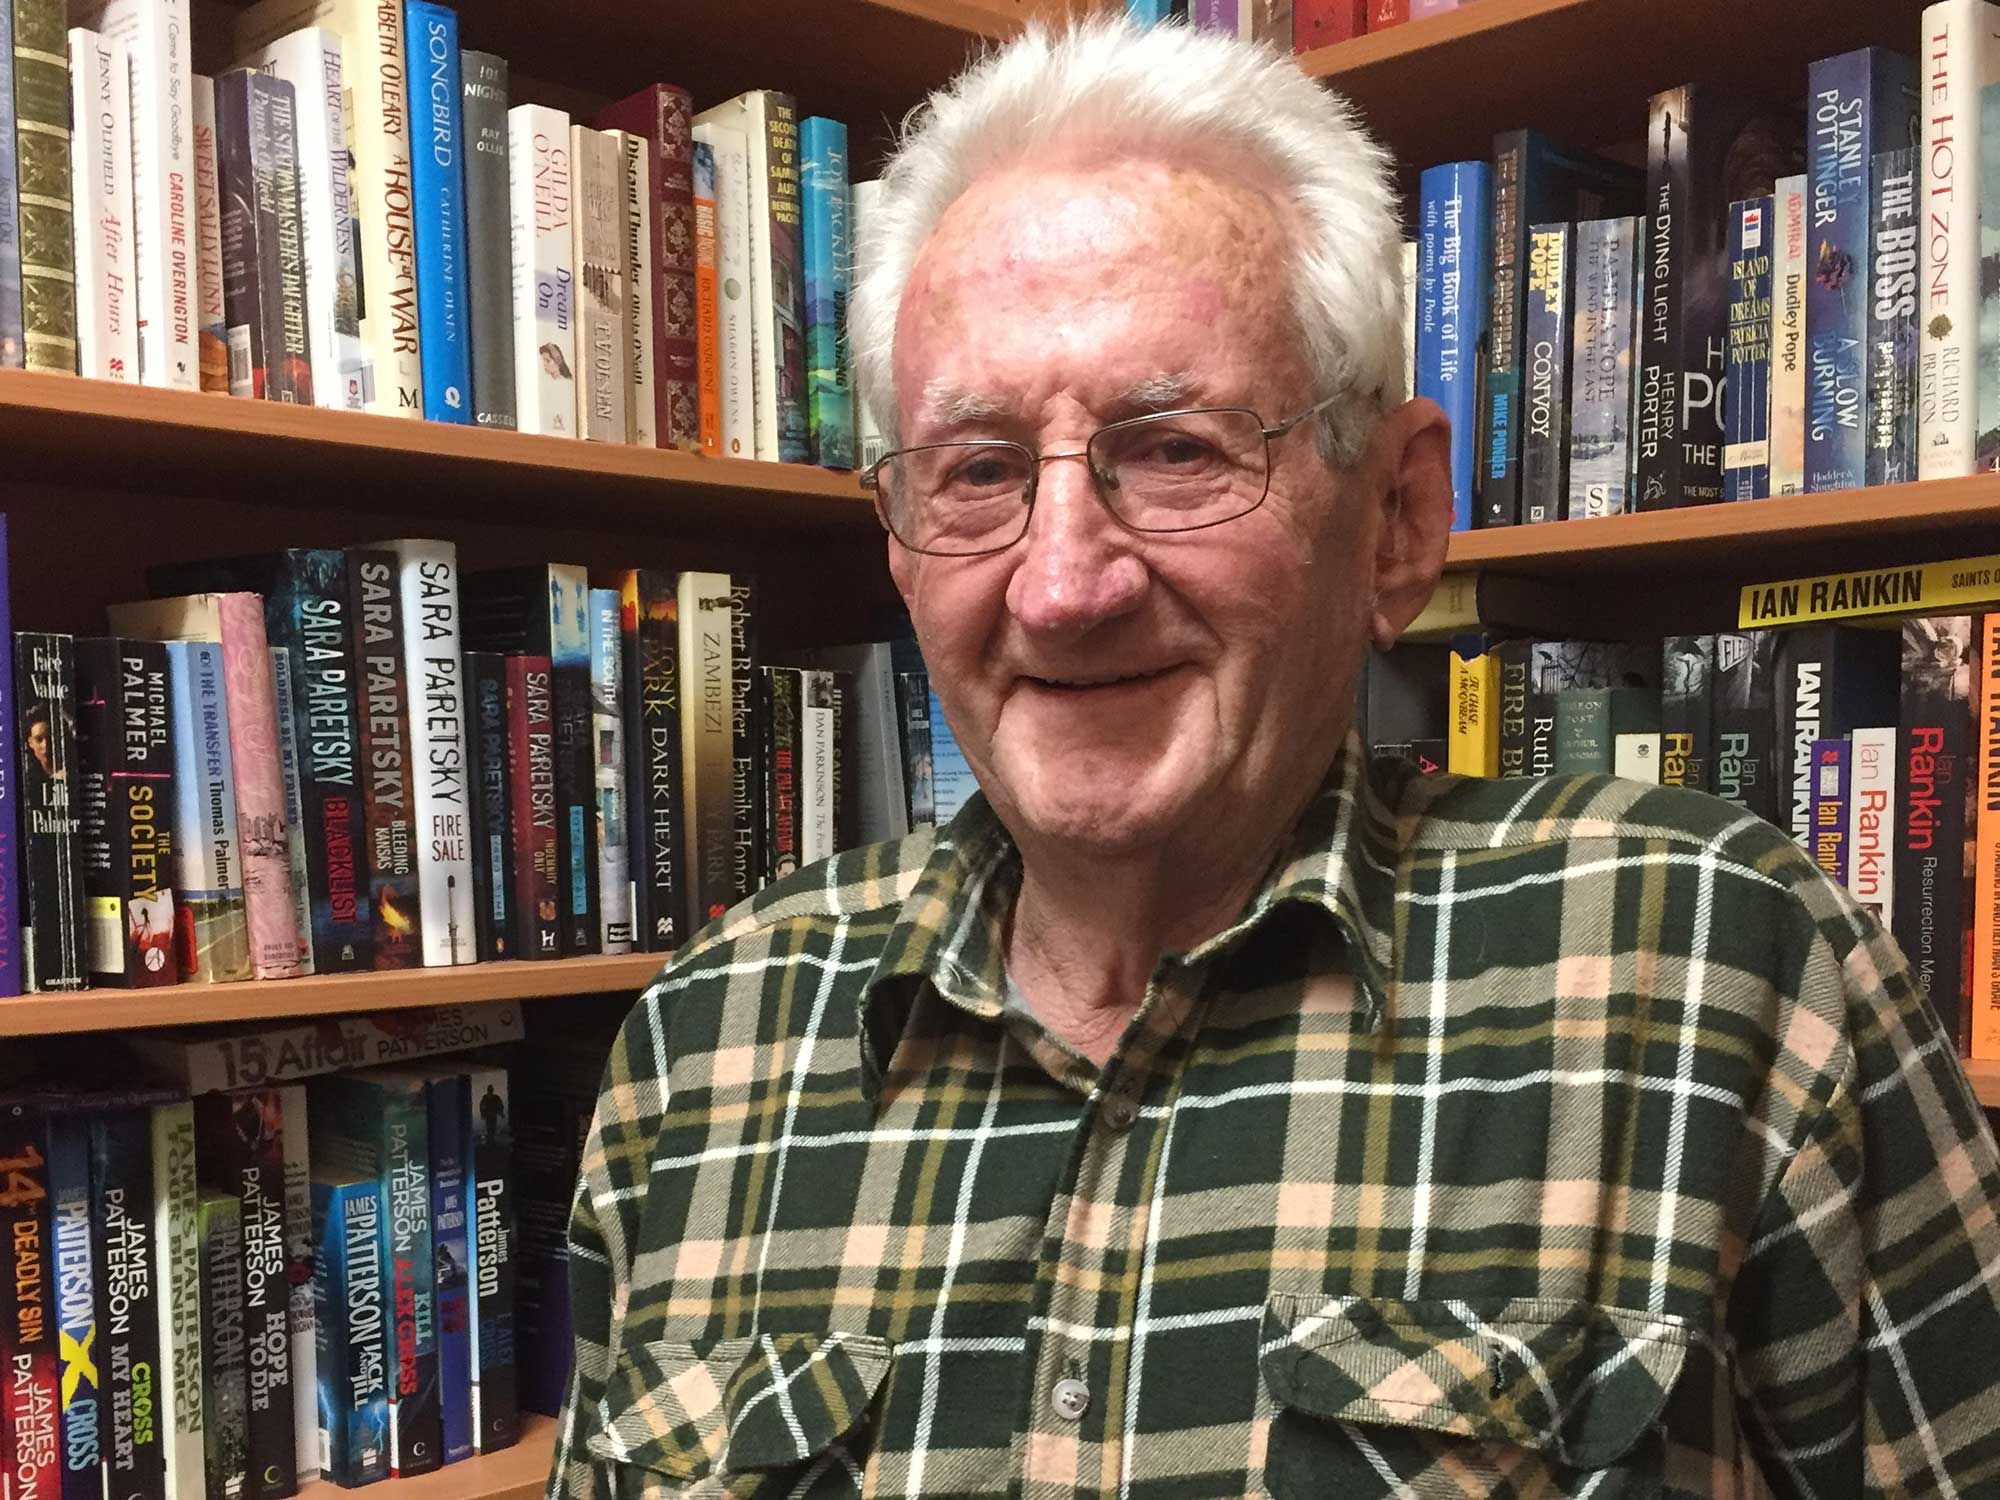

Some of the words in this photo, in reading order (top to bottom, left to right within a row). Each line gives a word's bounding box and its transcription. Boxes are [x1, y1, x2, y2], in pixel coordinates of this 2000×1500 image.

[97, 45, 113, 104] JENNY
[168, 78, 182, 100] Say
[322, 49, 342, 111] HEART
[427, 20, 452, 167] SONGBIRD
[1932, 23, 1948, 105] THE
[168, 104, 183, 160] Goodbye
[271, 95, 291, 127] THE
[379, 63, 403, 140] O'LEARY
[196, 126, 214, 191] SWEET
[393, 154, 408, 166] A
[626, 140, 640, 203] Distant
[1814, 89, 1839, 228] POTTINGER
[1838, 97, 1863, 206] STANLEY
[1930, 113, 1954, 202] HOT
[169, 173, 186, 245] CAROLINE
[331, 148, 353, 255] WILDERNESS
[384, 168, 414, 264] HOUSE
[532, 133, 552, 238] O'NEILL
[551, 149, 569, 229] GILDA
[1426, 200, 1438, 229] with
[1443, 195, 1463, 230] The
[1659, 183, 1670, 212] THE
[1882, 171, 1913, 219] THE
[104, 209, 121, 263] After
[198, 192, 218, 256] SALLY
[441, 187, 455, 284] CATHERINE
[628, 210, 643, 285] Thunder
[696, 204, 714, 236] BASIC
[1438, 236, 1460, 264] Big
[1653, 214, 1673, 279] DYING
[1423, 233, 1436, 273] poems
[1529, 232, 1547, 291] POPE
[1543, 231, 1563, 315] DUDLEY
[1875, 224, 1916, 321] BOSS
[1930, 211, 1950, 306] ZONE
[106, 272, 124, 335] Hours
[172, 250, 189, 344] OVERINGTON
[444, 290, 457, 342] OLSEN
[536, 281, 555, 309] On
[554, 266, 572, 331] Dream
[700, 276, 714, 330] RICHARD
[1422, 277, 1437, 294] by
[1423, 298, 1436, 333] Poole
[1440, 271, 1460, 318] Book
[1652, 283, 1669, 344] LIGHT
[1730, 298, 1770, 323] DREAMS
[1782, 274, 1801, 329] Dudley
[389, 286, 419, 355] WAR
[728, 314, 739, 367] SHARON
[1440, 323, 1458, 342] of
[1780, 331, 1799, 372] Pope
[1836, 337, 1858, 354] A
[1439, 348, 1458, 382] Life
[1599, 342, 1618, 402] POPE
[1731, 344, 1767, 365] POTTER
[1941, 346, 1960, 424] RICHARD
[730, 375, 740, 425] OWENS
[1492, 393, 1508, 427] MIKE
[1530, 341, 1554, 438] CONVOY
[1640, 365, 1661, 458] PORTER
[1659, 373, 1675, 439] HENRY
[1835, 358, 1859, 429] SLOW
[1922, 353, 1938, 425] PRESTON
[1490, 429, 1507, 479] PONDER
[1682, 443, 1716, 466] THE
[360, 561, 394, 644] SARA
[420, 561, 453, 641] SARA
[600, 609, 614, 623] IN
[730, 585, 752, 651] Robert
[1751, 584, 1800, 621] IAN
[1809, 569, 1923, 614] RANKIN
[1951, 569, 1990, 588] SAINTS
[32, 647, 63, 674] Face
[301, 599, 344, 661] SARA
[602, 626, 615, 652] THE
[31, 673, 70, 700] Value
[121, 657, 148, 761] PALMER
[147, 671, 167, 748] MICHAEL
[200, 670, 217, 698] THE
[525, 672, 551, 724] SARA
[601, 656, 617, 705] SOUTH
[703, 632, 723, 734] ZAMBEZI
[731, 679, 753, 738] Parker
[1468, 693, 1480, 726] CHASE
[1502, 661, 1526, 738] FIRE
[1795, 661, 1822, 718] IAN
[201, 702, 223, 777] TRANSFER
[307, 669, 353, 785] PARETSKY
[366, 656, 404, 808] PARETSKY
[424, 657, 463, 805] PARETSKY
[815, 711, 826, 738] DAN
[1532, 716, 1555, 778] Ruth
[529, 733, 556, 829] PARETSKY
[651, 727, 671, 800] DARK
[815, 740, 826, 807] PARKINSON
[1742, 759, 1760, 786] Ian
[1791, 720, 1820, 849] RANKIN
[1861, 743, 1884, 779] Ian
[1907, 726, 1945, 849] Rankin
[1936, 754, 1957, 785] Ian
[32, 809, 81, 835] Palmer
[208, 780, 226, 836] Thomas
[432, 814, 463, 838] FIRE
[1818, 801, 1843, 826] Ian
[127, 785, 159, 903] SOCIETY
[157, 830, 170, 856] THE
[213, 839, 231, 890] Palmer
[323, 799, 357, 923] BLACKLIST
[374, 827, 392, 870] KANSAS
[391, 819, 409, 875] BLEEDING
[431, 837, 465, 864] SALE
[533, 850, 546, 873] ONLY
[543, 838, 558, 885] INDEMNITY
[653, 808, 673, 892] HEART
[733, 828, 753, 894] Honor
[1858, 789, 1888, 896] Rankin
[1920, 856, 1938, 955] Resurrection
[1920, 959, 1936, 993] Men
[377, 1023, 489, 1061] PATTERSON
[178, 1122, 198, 1238] JAMES
[344, 1195, 377, 1218] JAMES
[390, 1123, 412, 1253] PATTERSON
[408, 1160, 427, 1233] JAMES
[12, 1220, 41, 1302] DEADLY
[56, 1200, 93, 1331] PATTERSON
[104, 1188, 129, 1335] PATTERSON
[126, 1217, 149, 1301] JAMES
[241, 1167, 266, 1307] PATTERSON
[262, 1196, 284, 1275] JAMES
[476, 1178, 504, 1298] Patterson
[497, 1227, 511, 1264] James
[170, 1234, 186, 1335] BLIND
[344, 1213, 384, 1346] PATTERSON
[394, 1258, 416, 1319] ALEX
[17, 1307, 43, 1344] SIN
[183, 1247, 202, 1434] PATTERSON
[413, 1290, 434, 1345] KILL
[111, 1343, 130, 1384] MY
[248, 1332, 268, 1368] TO
[265, 1310, 289, 1388] HOPE
[359, 1342, 384, 1393] JACK
[398, 1322, 418, 1396] CROSS
[131, 1361, 153, 1445] CROSS
[173, 1346, 187, 1435] MICE
[250, 1370, 270, 1411] DIE
[349, 1373, 369, 1412] JILL
[11, 1353, 38, 1500] PATTERSON
[32, 1381, 55, 1467] JAMES
[65, 1399, 99, 1471] CROSS
[112, 1391, 134, 1471] HEART
